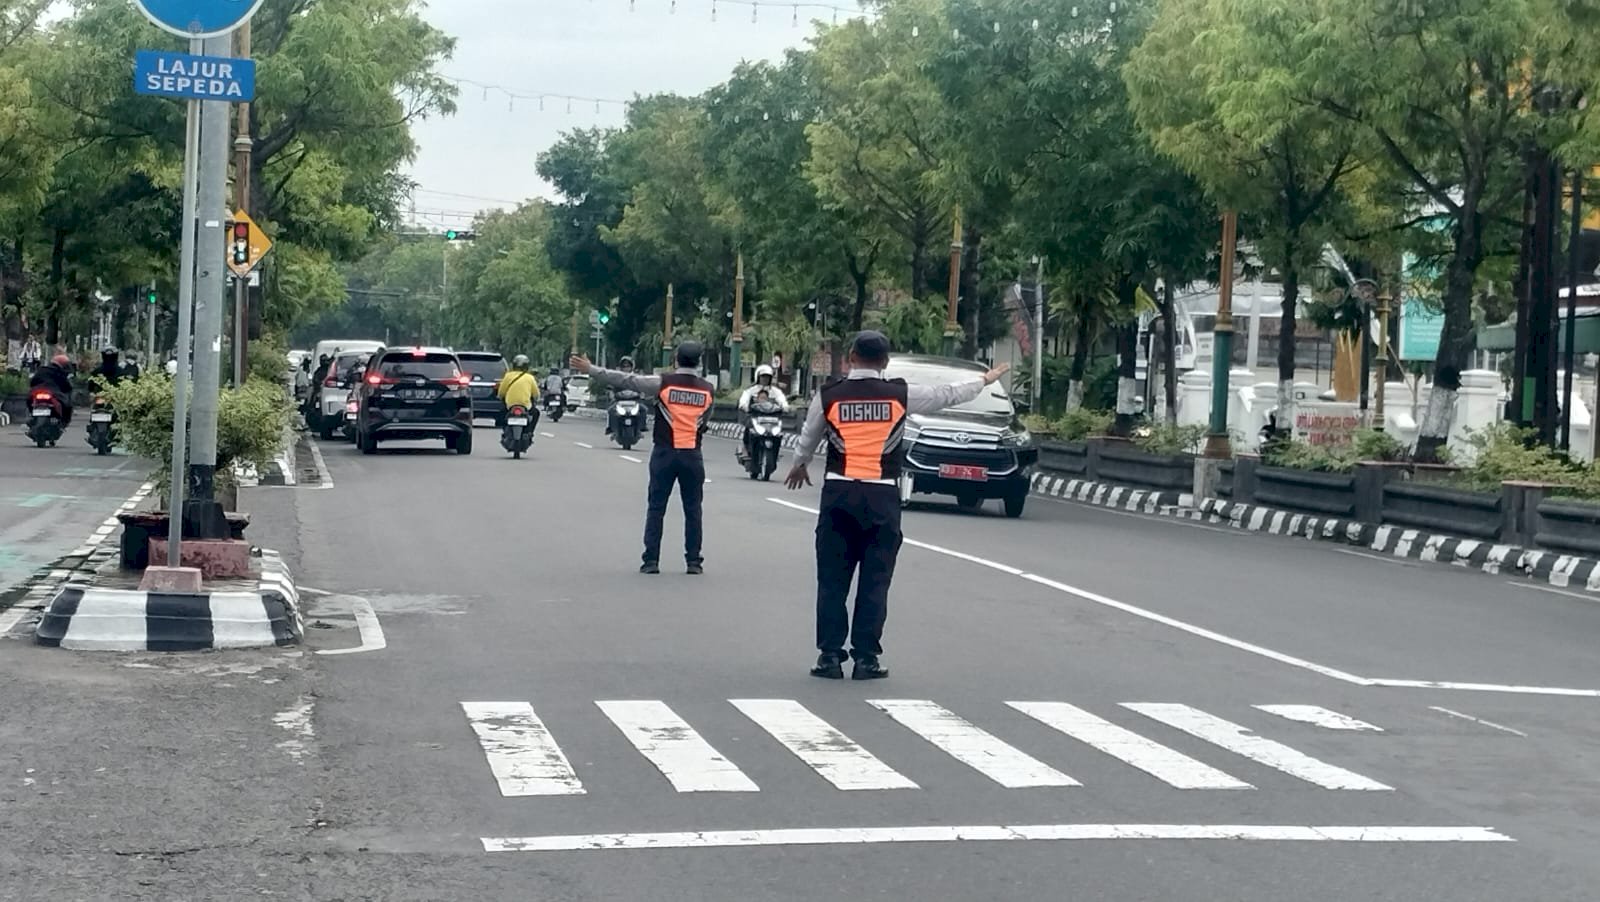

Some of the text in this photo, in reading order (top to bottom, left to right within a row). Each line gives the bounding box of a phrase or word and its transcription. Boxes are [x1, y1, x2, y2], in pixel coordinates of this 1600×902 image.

[158, 58, 232, 79] LAJUR
[147, 74, 242, 97] SEPEDA
[670, 391, 705, 406] DISHUB
[840, 404, 890, 421] DISHUB
